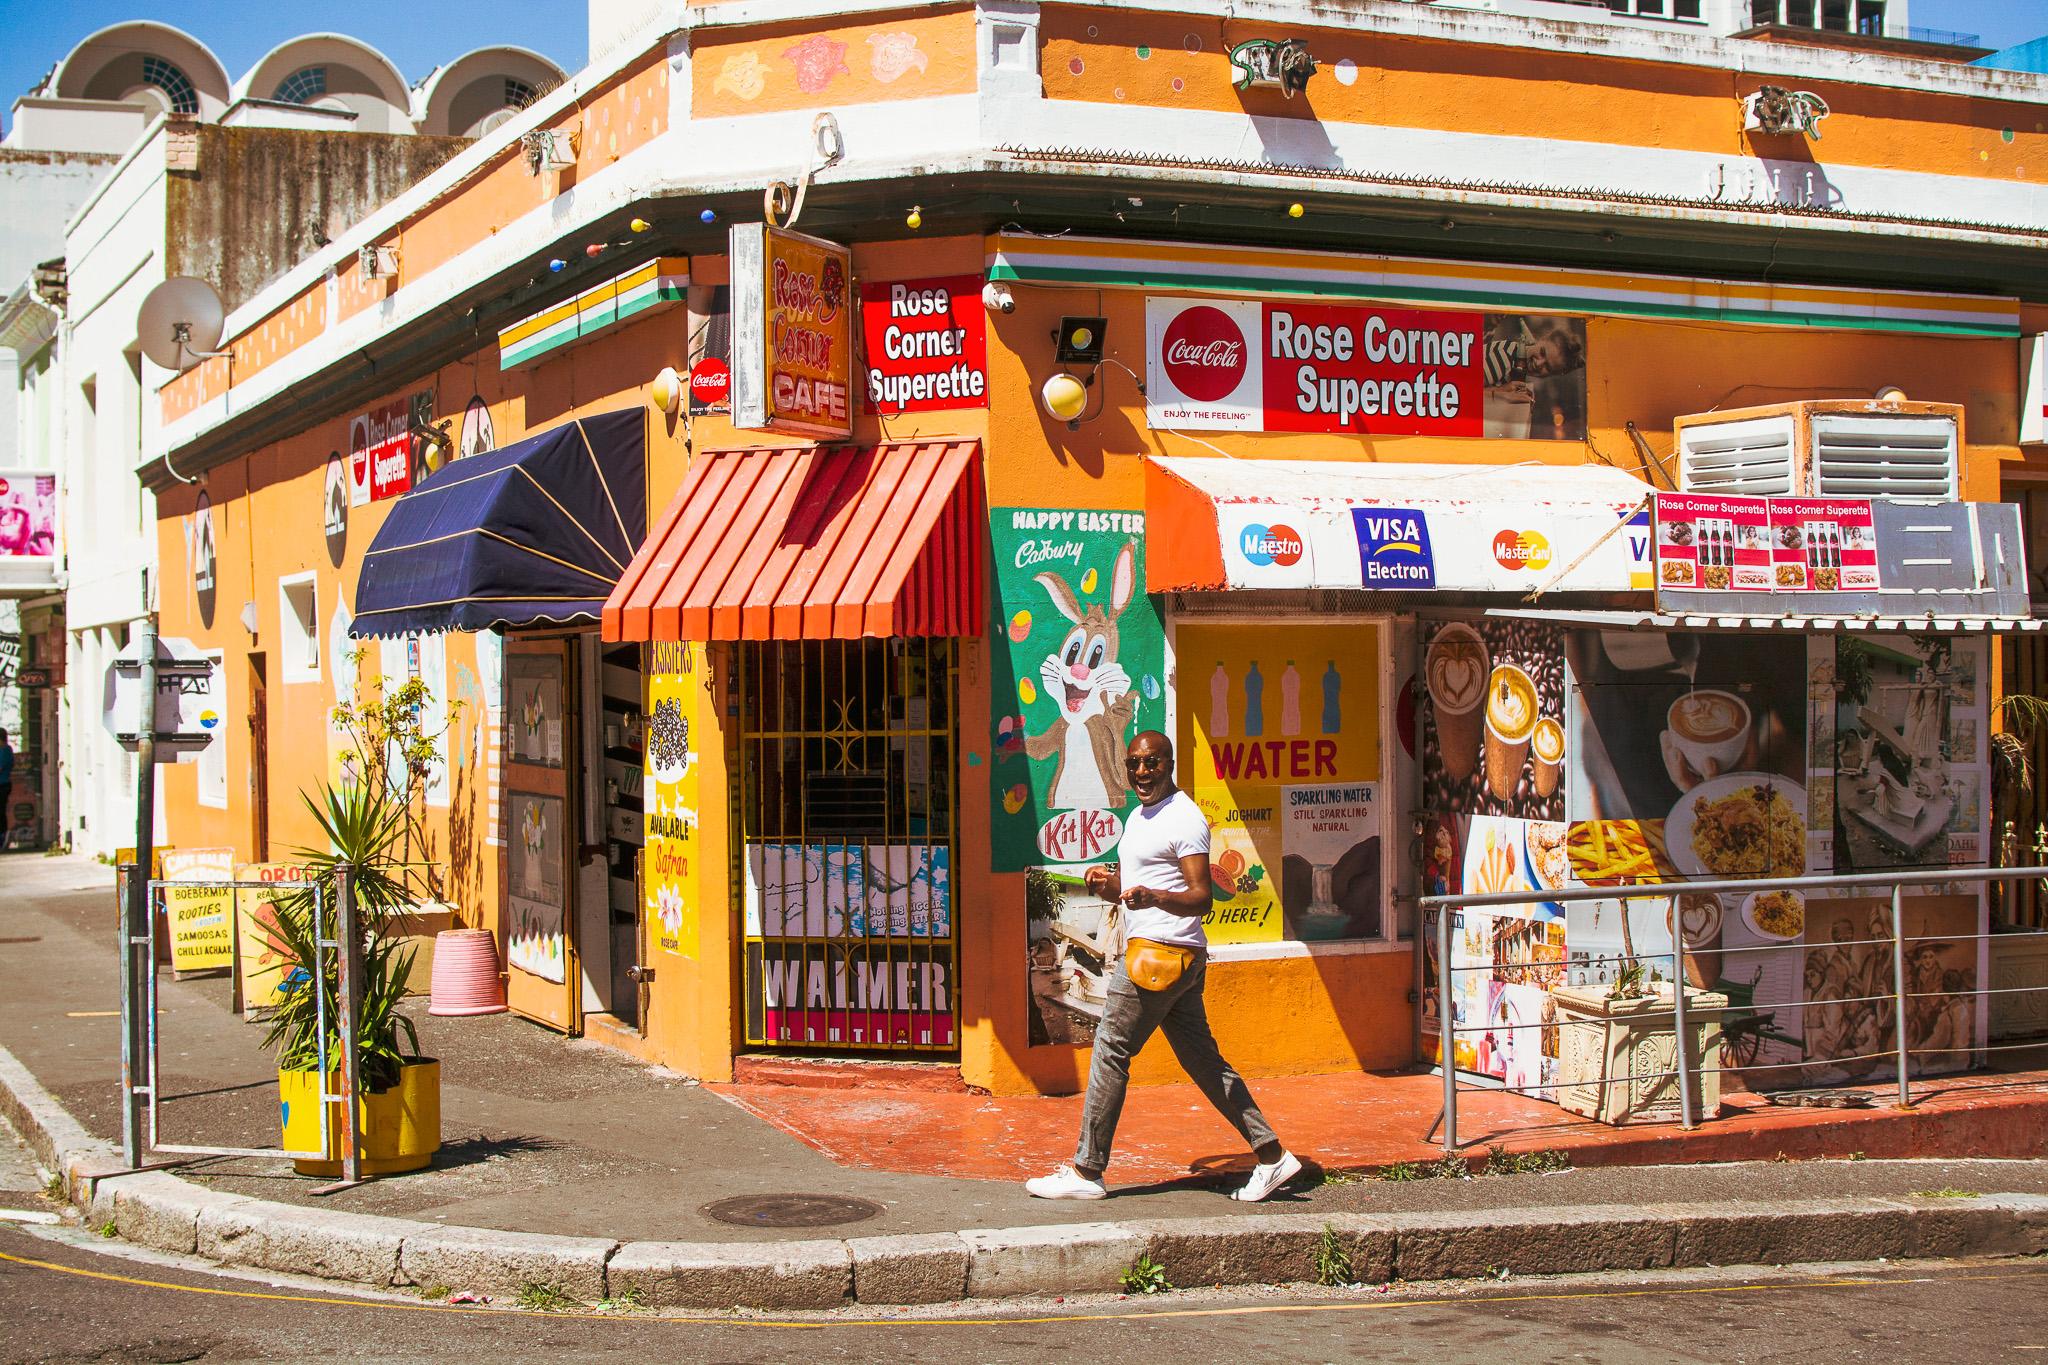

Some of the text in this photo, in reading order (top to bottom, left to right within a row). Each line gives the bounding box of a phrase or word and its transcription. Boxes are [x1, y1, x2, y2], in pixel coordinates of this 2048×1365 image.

[774, 257, 816, 315] Rose
[891, 284, 949, 317] Rose
[773, 313, 834, 373] Corner
[885, 325, 966, 360] Corner
[1271, 311, 1475, 367] Rose Corner
[1168, 338, 1241, 367] Coca-Cola
[693, 374, 728, 387] Coca-Cola
[869, 361, 984, 409] Superette
[773, 371, 847, 421] CAFE
[1296, 365, 1460, 426] Superette
[1164, 410, 1191, 419] ENJOY
[1194, 411, 1209, 419] THE
[370, 412, 408, 450] Rose Corner
[375, 446, 406, 492] Superette
[1660, 500, 1765, 515] Rose Corner Superette
[1770, 504, 1868, 516] Rose Corner Superette
[1012, 511, 1144, 534] HAPPY EASTER
[1366, 517, 1420, 541] VISA
[1015, 540, 1084, 568] Cadbury
[1244, 534, 1301, 555] Maestro
[1495, 542, 1552, 561] MasterCard
[1367, 562, 1429, 580] Electron
[1210, 740, 1338, 780] WATER
[1200, 798, 1220, 811] Belle
[1290, 788, 1372, 806] SPARKLING WATER
[1225, 808, 1273, 822] JOGHURT
[1294, 807, 1368, 820] STILL SPARKLING
[1312, 822, 1350, 832] NATURAL
[656, 844, 688, 881] Safran
[175, 887, 229, 901] BOEBERMIX
[178, 903, 221, 922] ROOTIES
[870, 900, 941, 917] Noting IGGR
[1219, 901, 1273, 928] HERE!
[871, 917, 906, 929] Noting
[177, 929, 228, 942] SAMOOSAS
[177, 946, 203, 956] CHILLI
[761, 960, 952, 1010] WALMER
